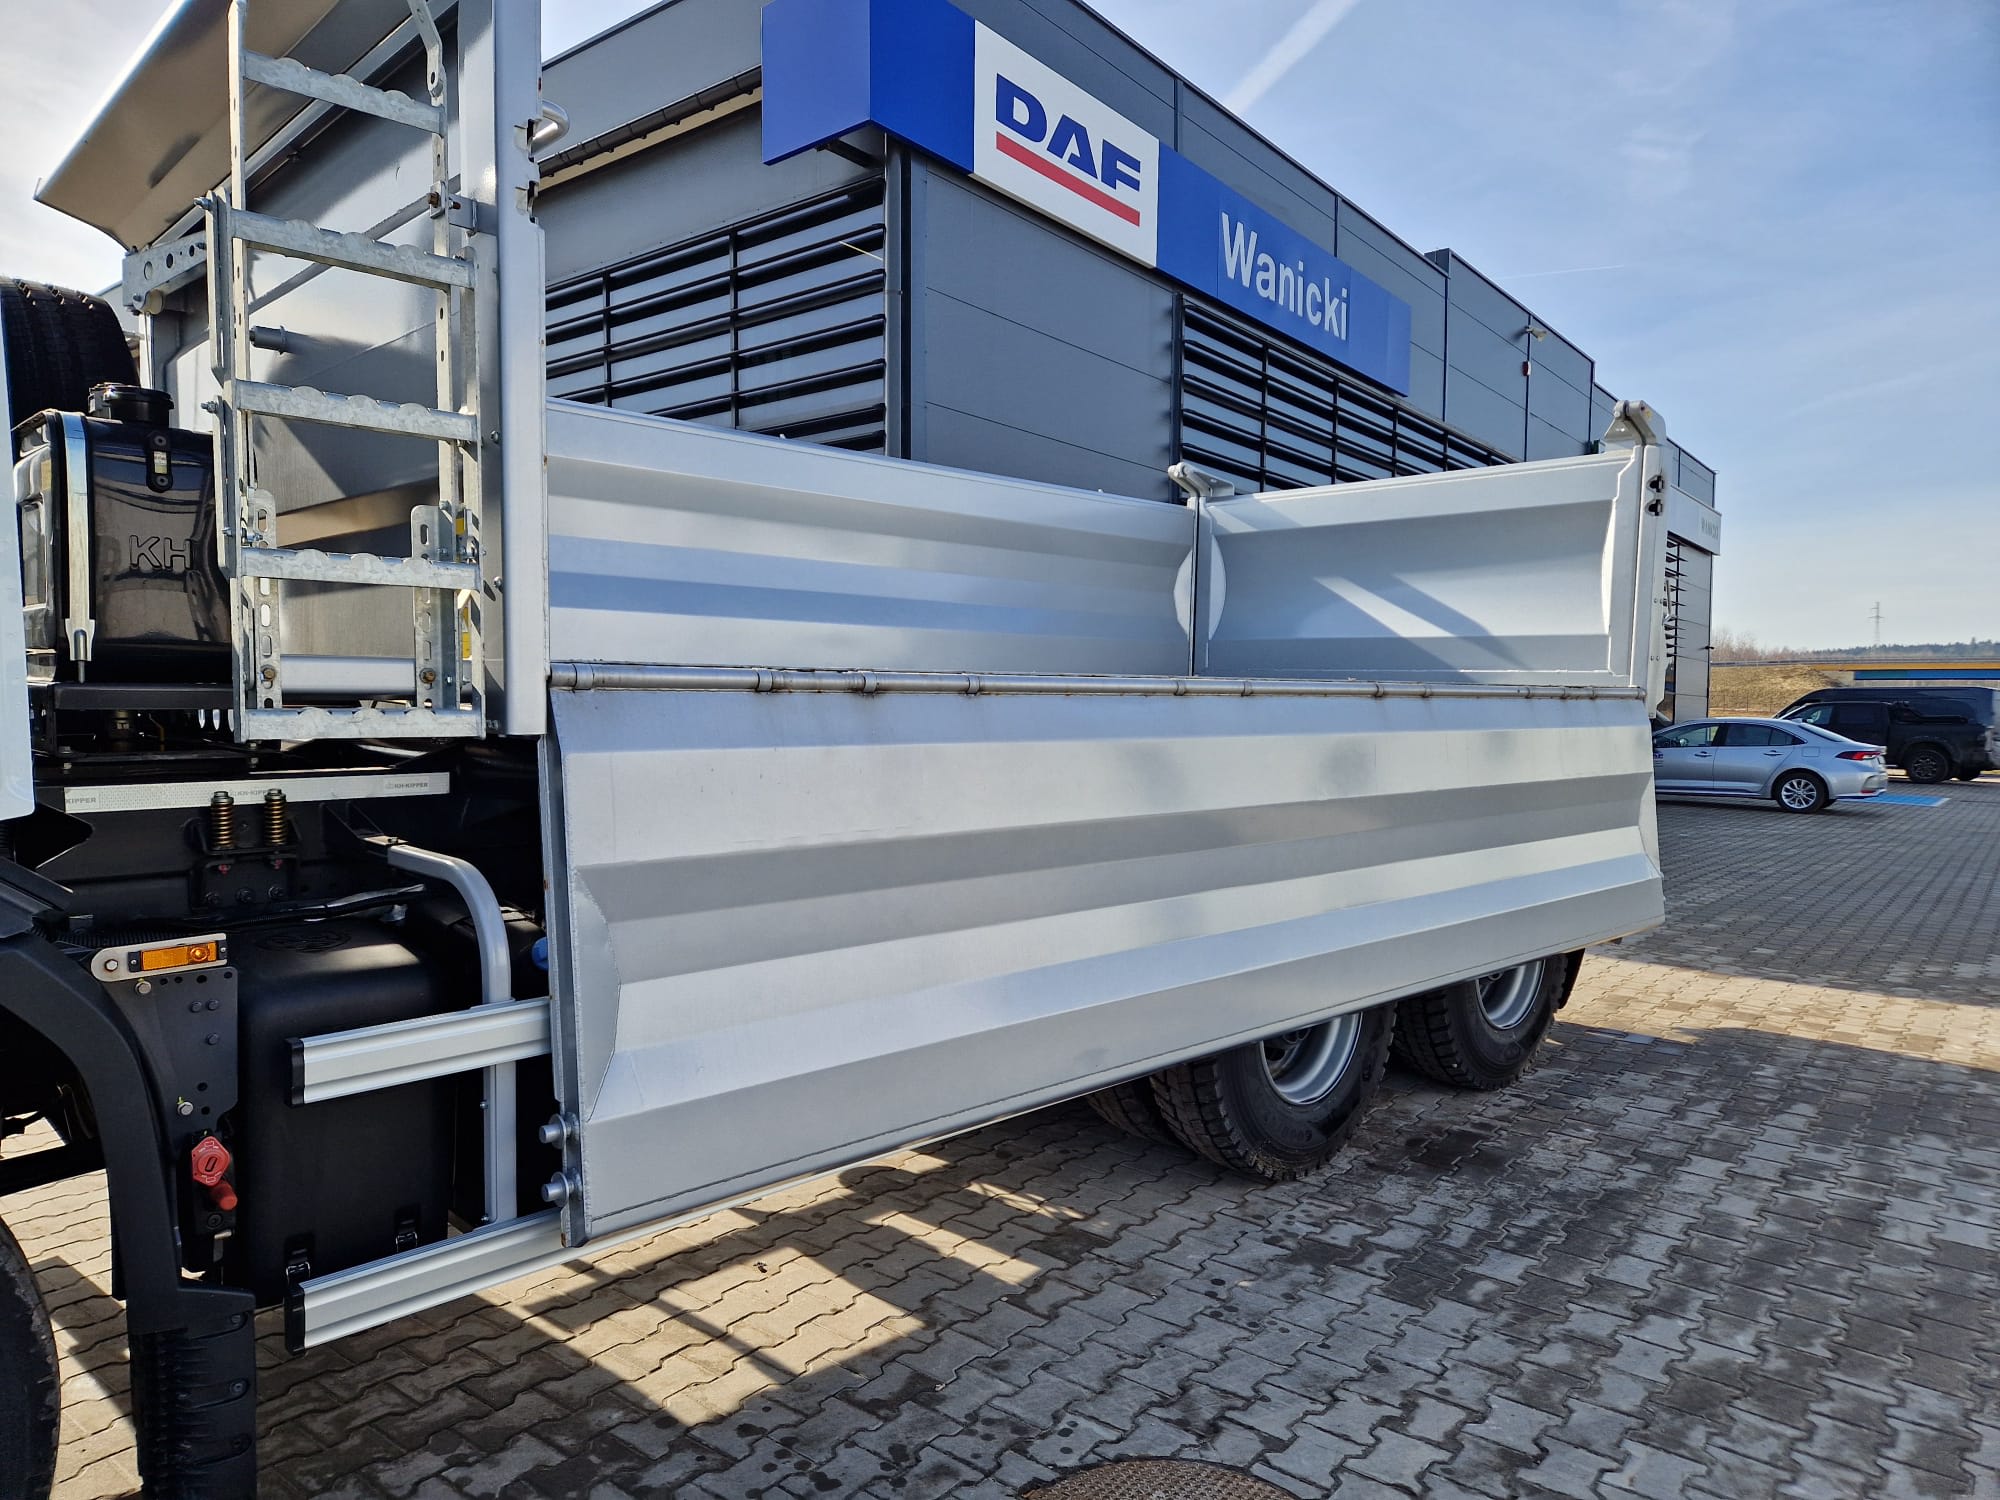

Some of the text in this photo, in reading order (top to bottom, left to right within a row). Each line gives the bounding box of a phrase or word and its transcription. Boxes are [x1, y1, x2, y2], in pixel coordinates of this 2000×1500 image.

[995, 72, 1141, 192] DAF
[1221, 211, 1348, 341] Wanicki
[129, 534, 192, 570] KH
